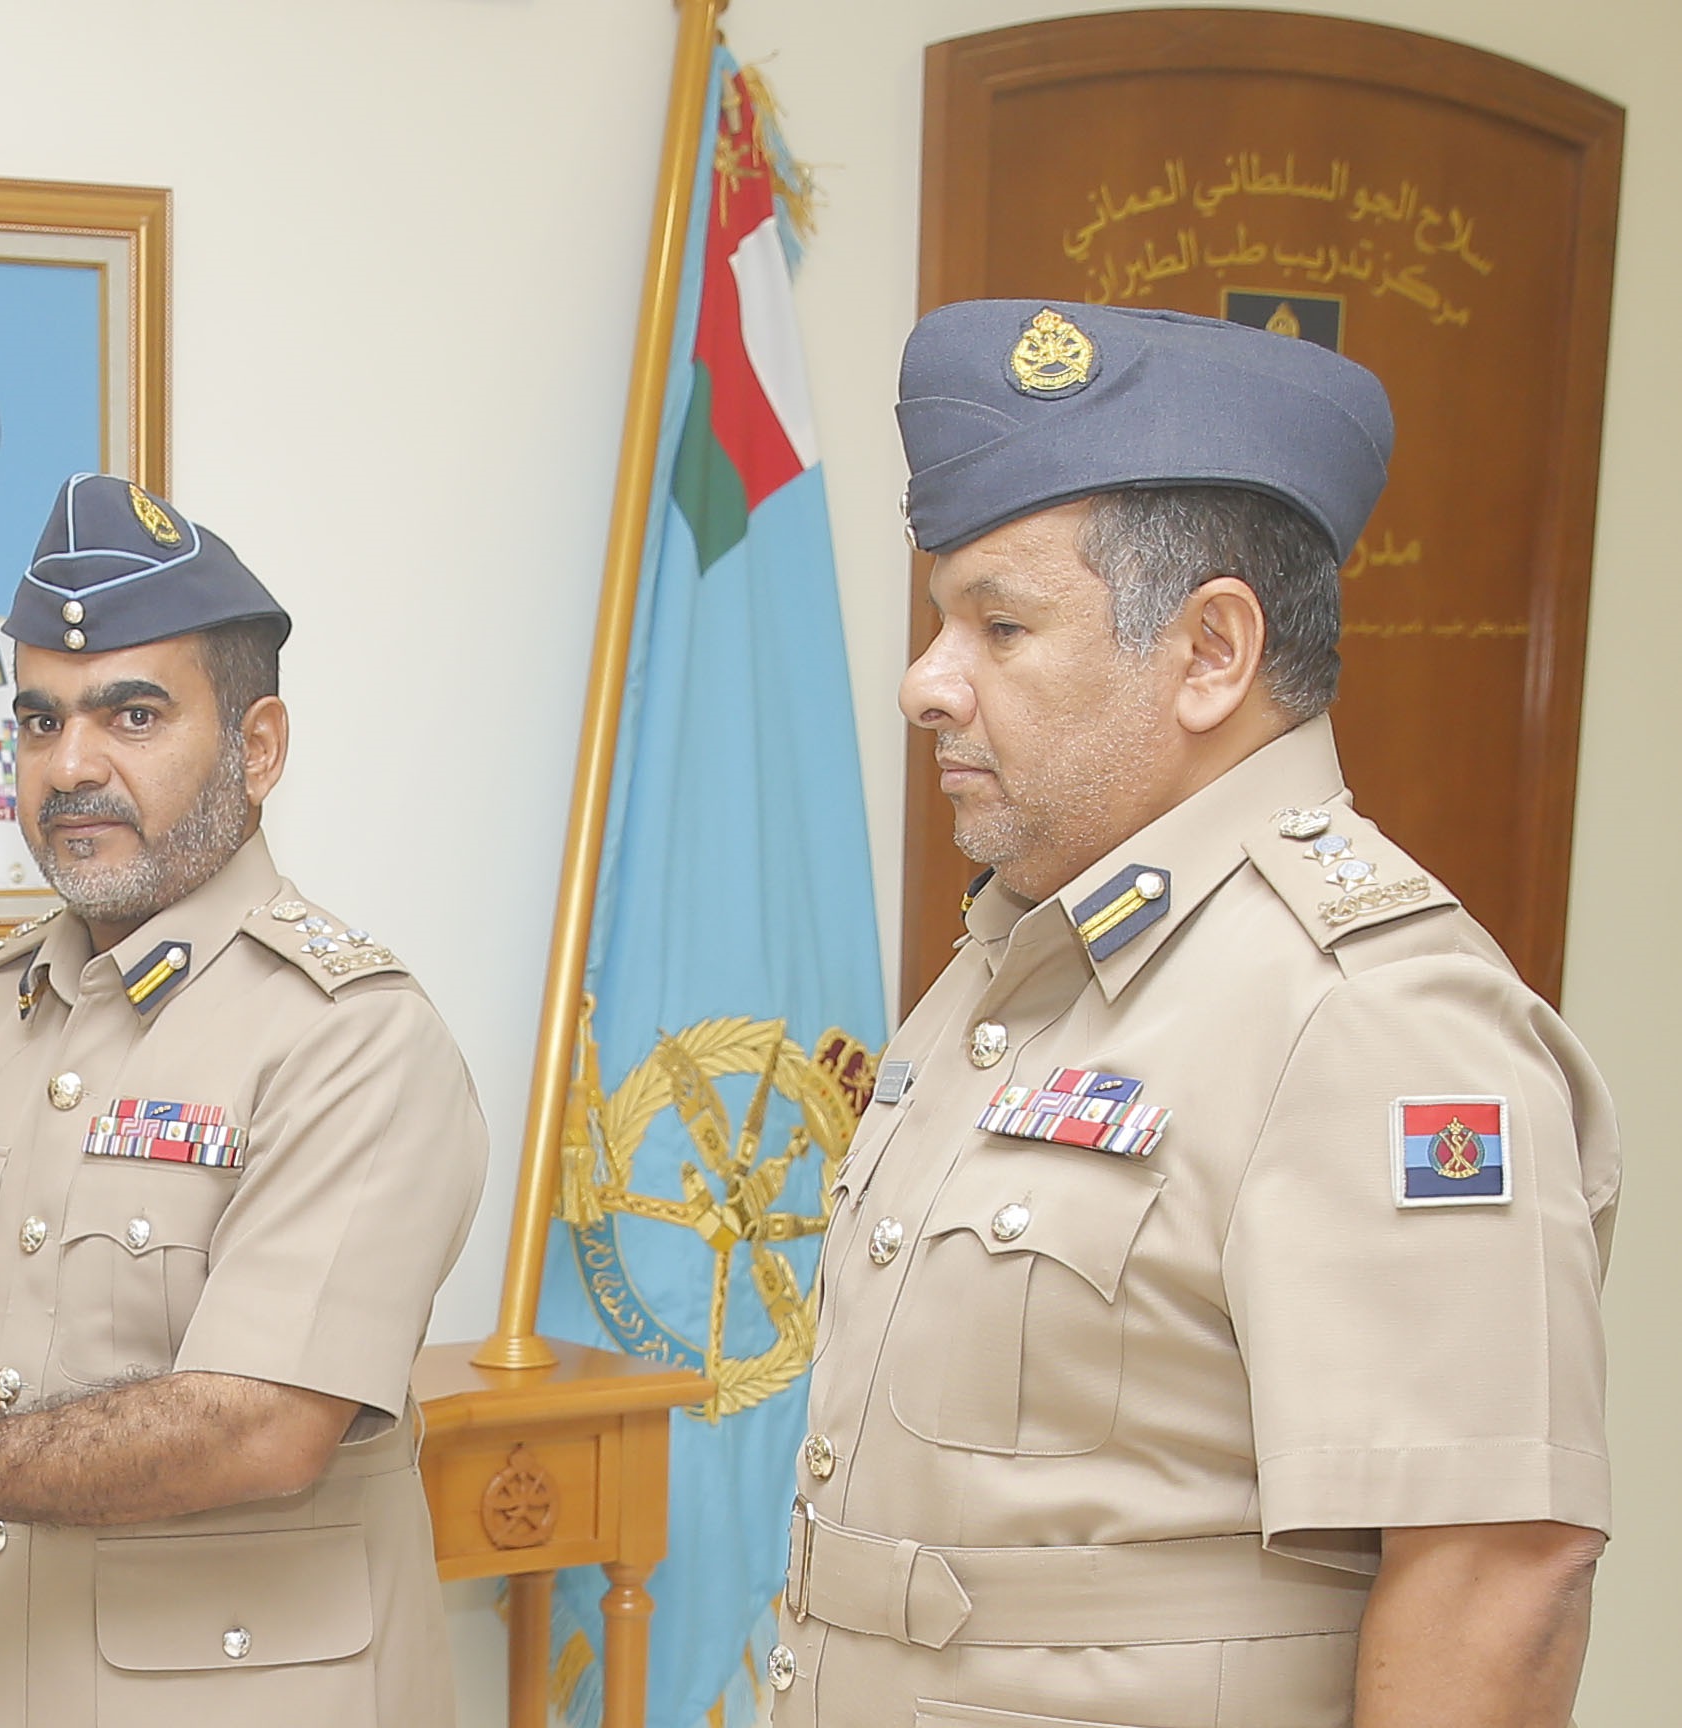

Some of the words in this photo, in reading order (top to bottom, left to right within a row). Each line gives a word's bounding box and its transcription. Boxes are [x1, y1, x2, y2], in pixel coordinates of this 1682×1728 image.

[1063, 156, 1187, 262] العماني
[1193, 151, 1350, 218] السلطاني
[1346, 179, 1418, 226] الجو
[1084, 226, 1199, 304] الطيران
[1203, 220, 1268, 279] طب
[1273, 238, 1374, 284] تدريب
[1414, 205, 1495, 276] سلاح
[1371, 252, 1470, 328] مركز
